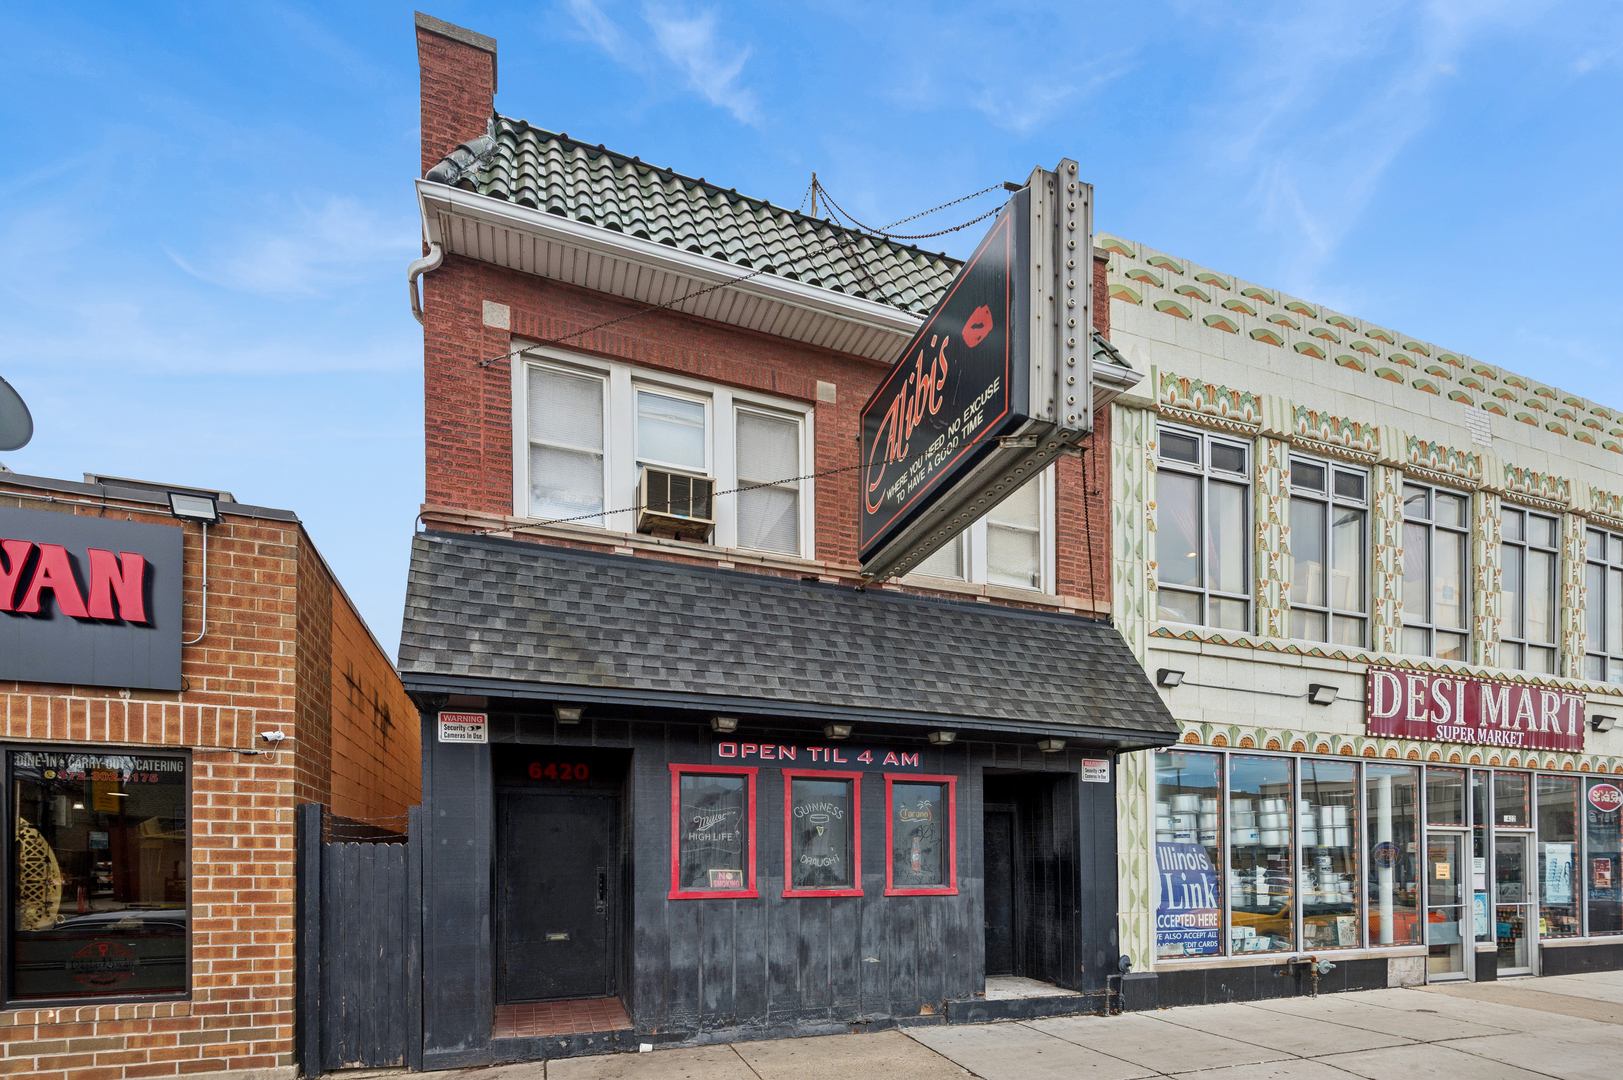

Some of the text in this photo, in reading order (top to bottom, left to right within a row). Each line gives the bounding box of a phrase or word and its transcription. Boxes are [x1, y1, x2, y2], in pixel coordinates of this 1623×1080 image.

[886, 376, 1000, 500] WHERE YOU NEED NO EXCUSE
[896, 410, 984, 504] TO HAVE A GOOD TIME
[1371, 670, 1584, 736] DESI MART
[443, 715, 483, 723] WARNING
[443, 723, 466, 732] Security
[1436, 725, 1525, 745] SUPER MARKET
[718, 741, 920, 767] OPEN TIL 4 AM
[136, 759, 184, 772] CATERING
[528, 762, 589, 780] 6420
[793, 802, 844, 819] GUINNESS
[900, 808, 929, 819] Corona
[693, 811, 726, 831] Miller
[688, 832, 733, 841] HIGH LIFE
[800, 853, 840, 867] DRAUGHT
[1158, 846, 1209, 871] Illinois
[1373, 848, 1400, 861] OPEN
[713, 879, 740, 888] SMOKING
[718, 872, 733, 880] NO
[1164, 872, 1217, 910] Link
[1156, 913, 1218, 928] CCEPTED HERE
[1198, 940, 1218, 948] CARDS
